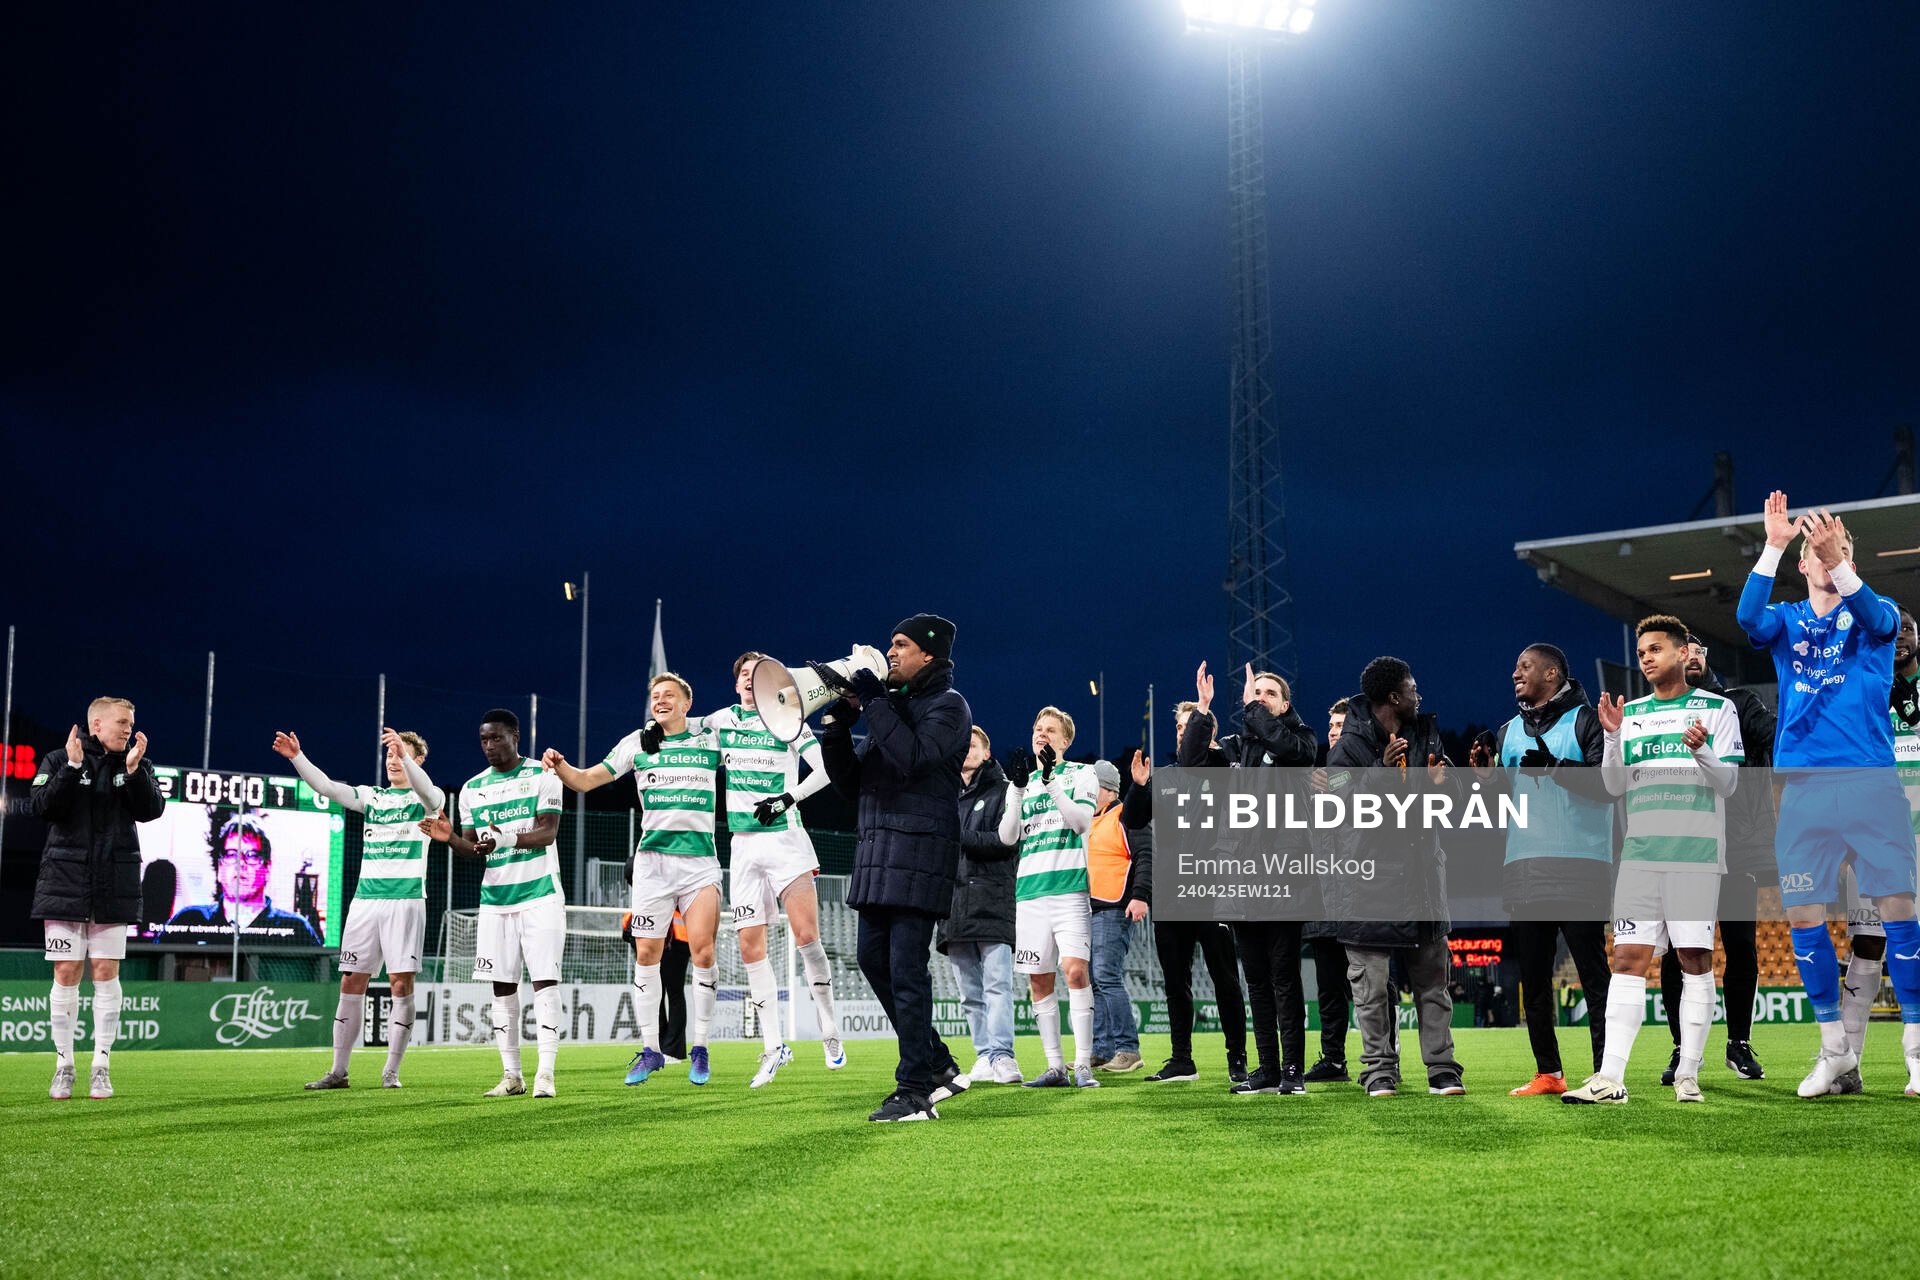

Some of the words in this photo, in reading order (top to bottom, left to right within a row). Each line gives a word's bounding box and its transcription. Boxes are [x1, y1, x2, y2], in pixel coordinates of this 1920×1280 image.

[736, 734, 776, 746] Telexia
[1644, 742, 1690, 755] Telexi
[661, 754, 709, 765] Telexia
[658, 774, 710, 784] Hygienteknik
[1641, 768, 1699, 779] Hygienteknik
[682, 795, 708, 805] Energy
[1663, 792, 1697, 802] Energy
[491, 805, 530, 821] Telexia
[1448, 939, 1503, 952] estaurang
[1, 996, 47, 1011] SANN
[209, 985, 323, 1047] Effecta
